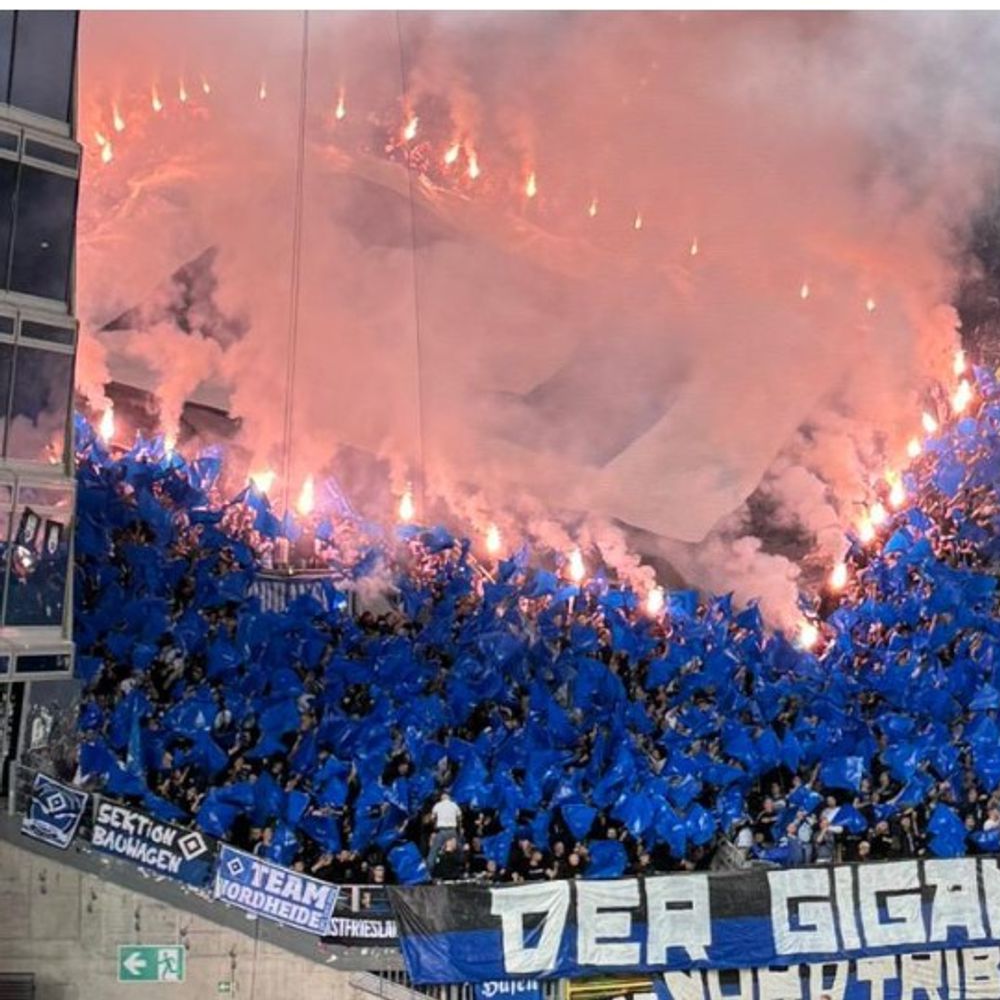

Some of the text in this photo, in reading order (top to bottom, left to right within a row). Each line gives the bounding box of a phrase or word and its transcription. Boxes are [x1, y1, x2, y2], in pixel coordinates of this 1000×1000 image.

[92, 824, 182, 873] BAUWAGEN
[98, 803, 177, 847] SEKTION
[251, 860, 330, 911] TEAM
[491, 873, 710, 974] DER
